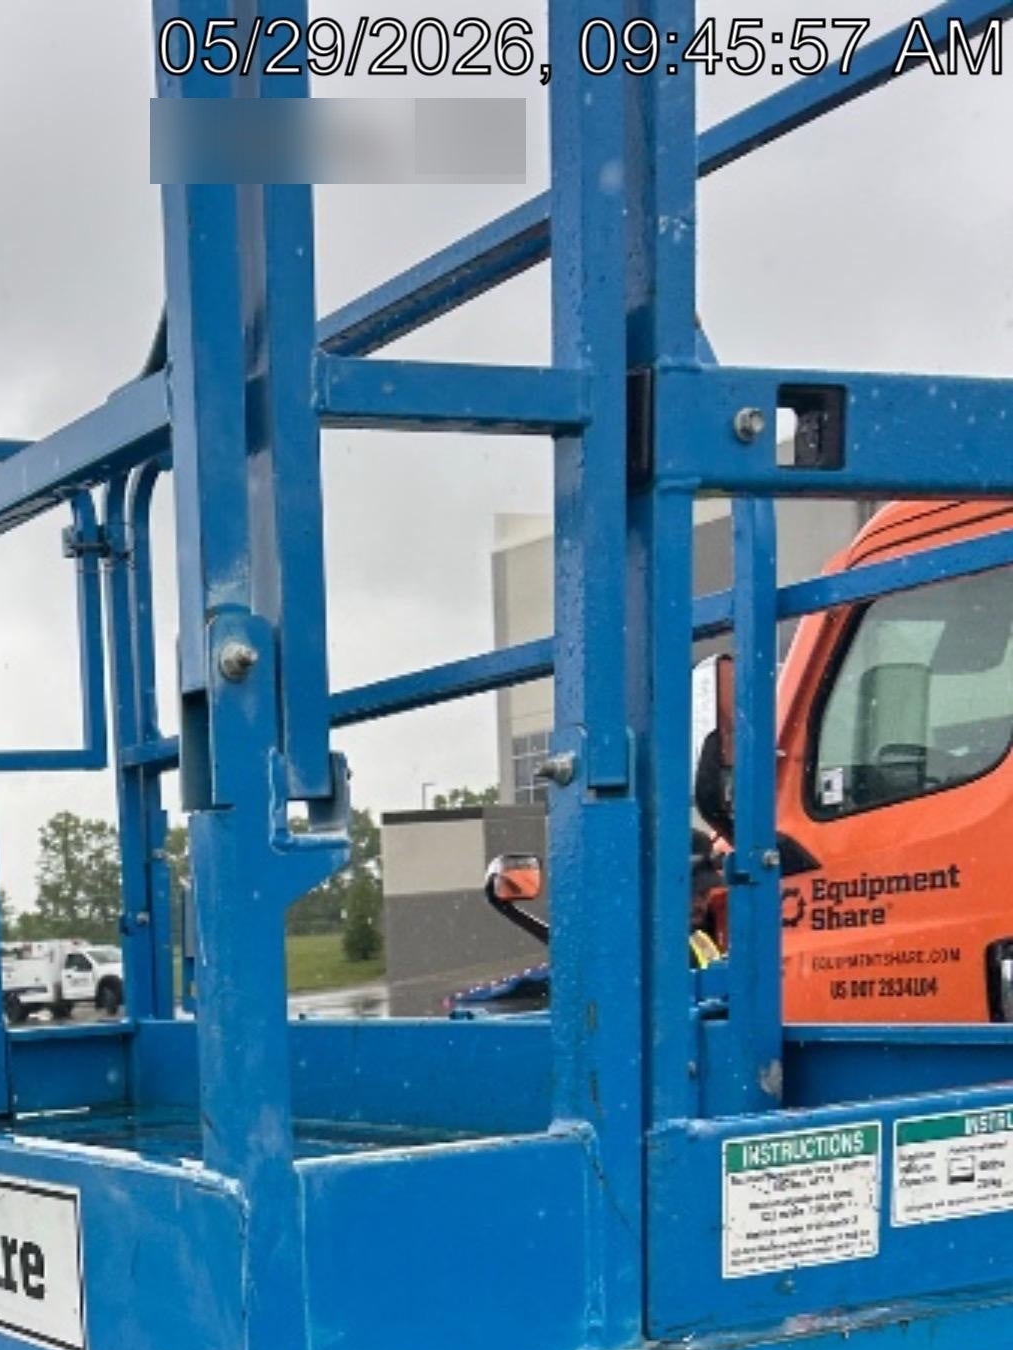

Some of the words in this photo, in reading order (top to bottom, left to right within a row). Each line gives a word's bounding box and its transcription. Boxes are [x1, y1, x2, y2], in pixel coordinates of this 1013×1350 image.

[812, 864, 960, 906] Equipment
[812, 907, 885, 931] Share
[743, 1131, 864, 1168] INSTRUCTIONS
